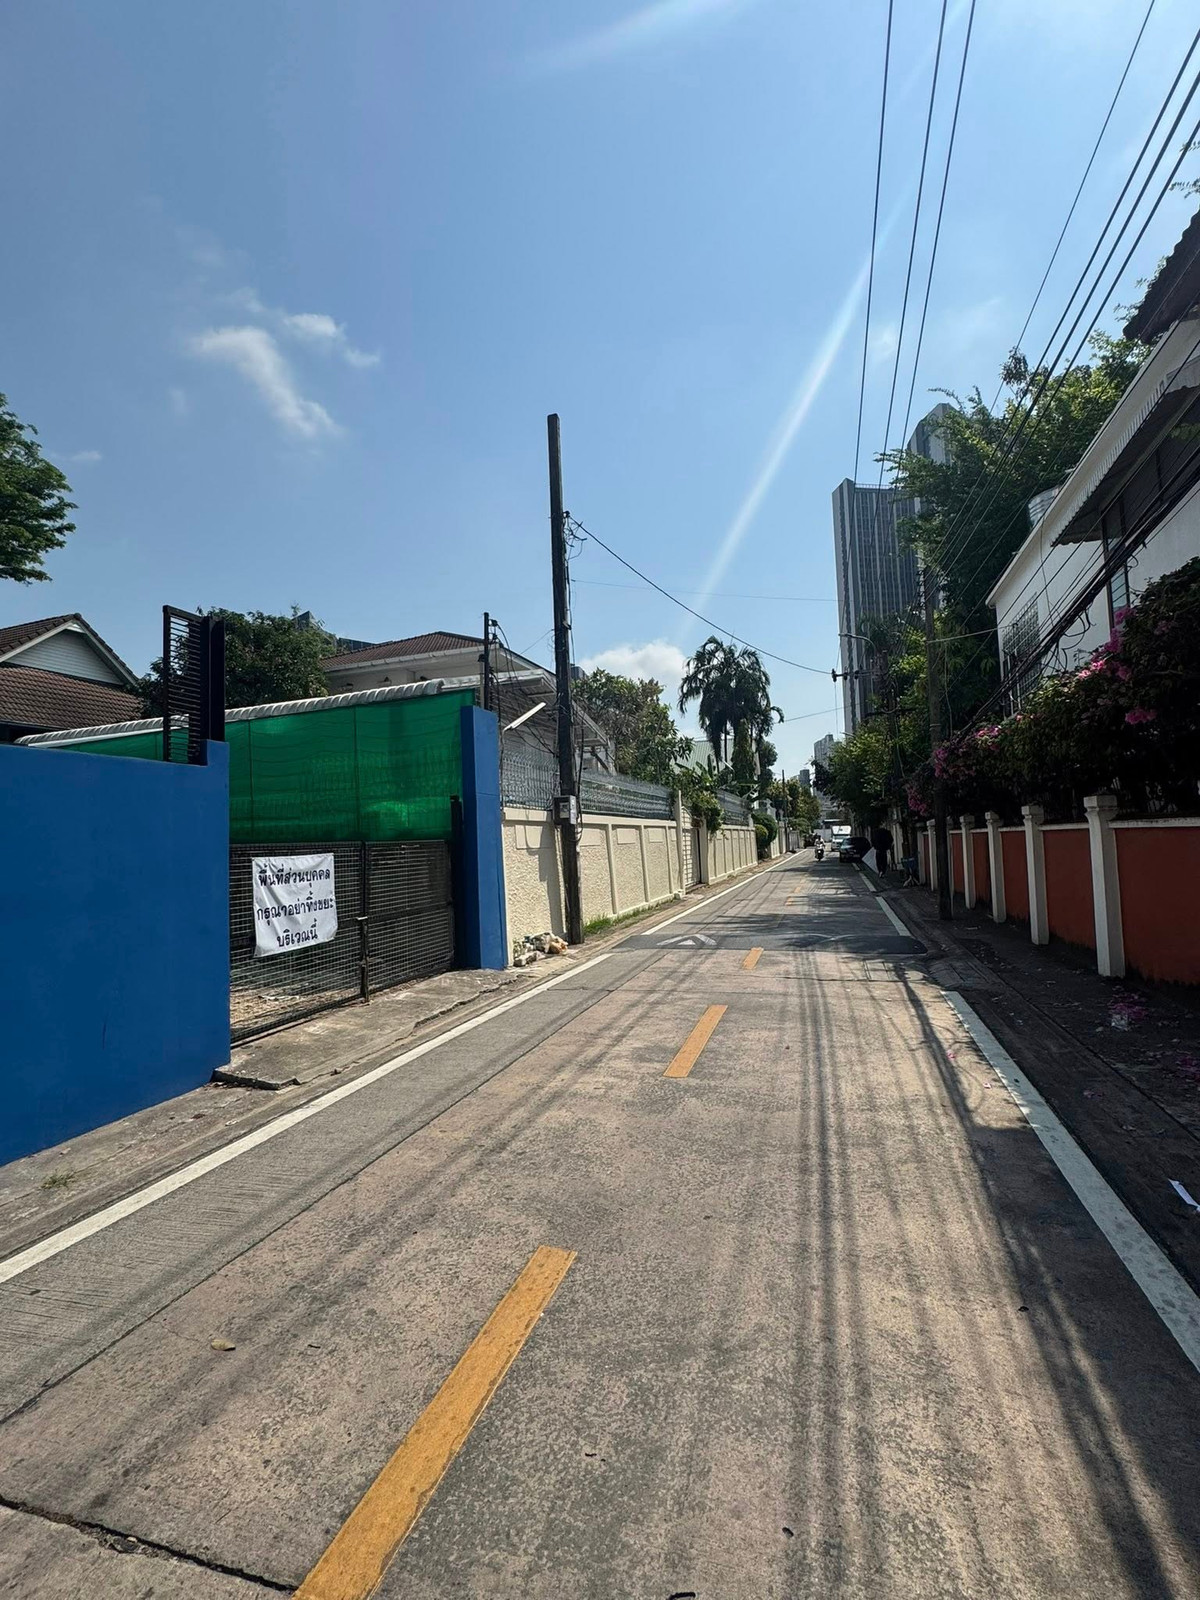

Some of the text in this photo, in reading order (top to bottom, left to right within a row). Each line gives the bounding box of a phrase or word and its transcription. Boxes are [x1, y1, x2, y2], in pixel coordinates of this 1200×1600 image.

[258, 863, 331, 888] พื้นที่ส่วนบุคคล
[256, 891, 334, 926] กรุณาอย่าทิ้งขยะ
[276, 918, 319, 948] บริเวณนี้
